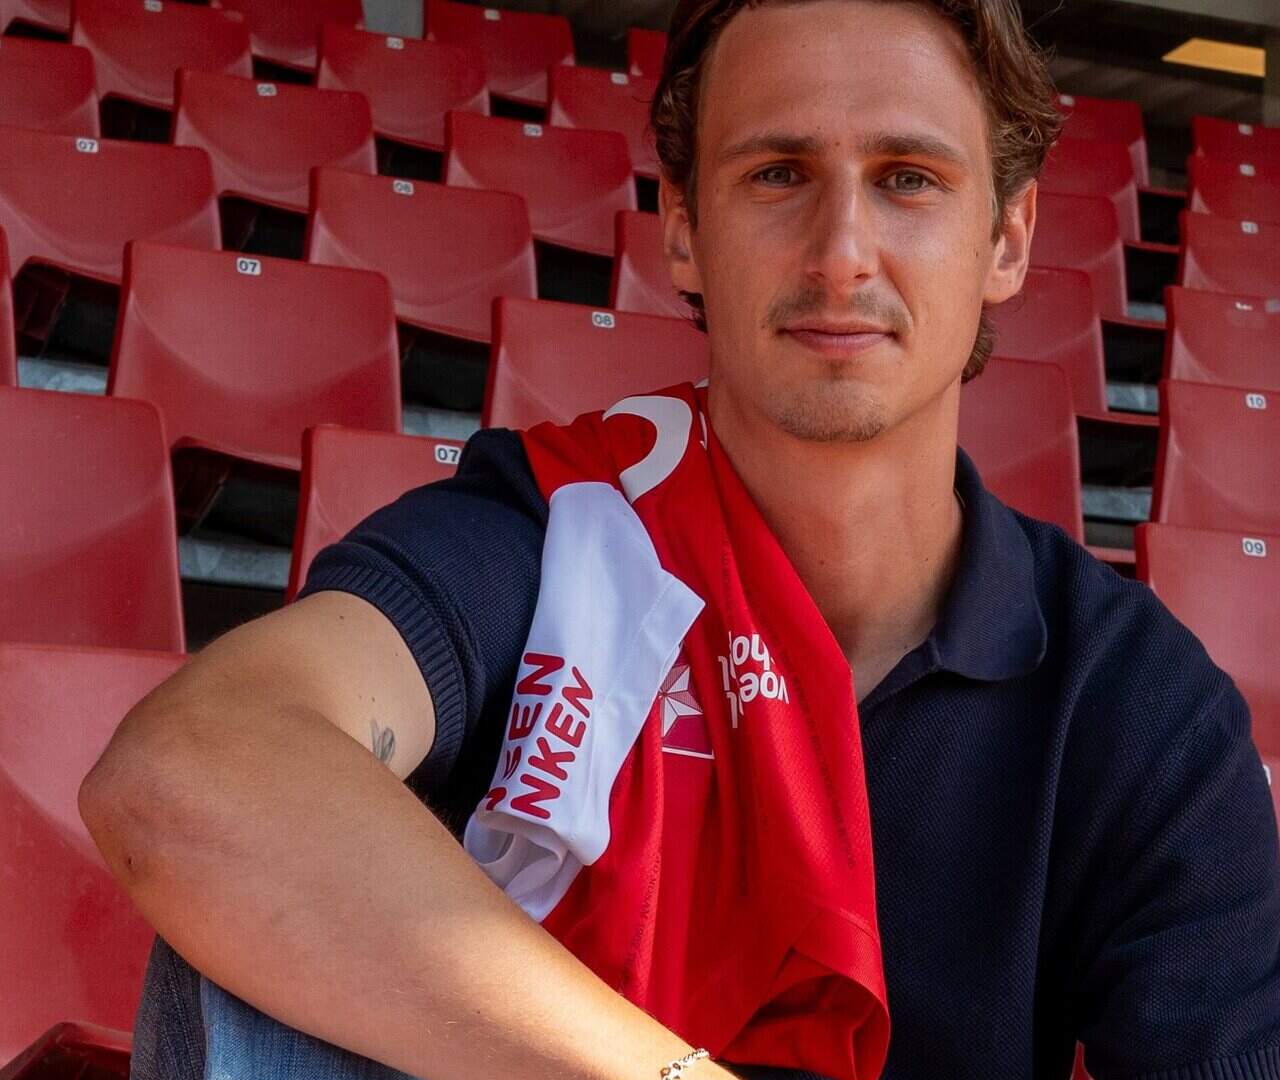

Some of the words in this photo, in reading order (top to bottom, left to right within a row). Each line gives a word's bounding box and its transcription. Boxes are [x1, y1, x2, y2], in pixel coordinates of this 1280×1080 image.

[78, 140, 96, 151] 07
[239, 260, 258, 273] 07
[593, 314, 612, 326] 08
[1249, 396, 1264, 408] 10
[437, 447, 459, 462] 07
[1244, 541, 1263, 554] 09
